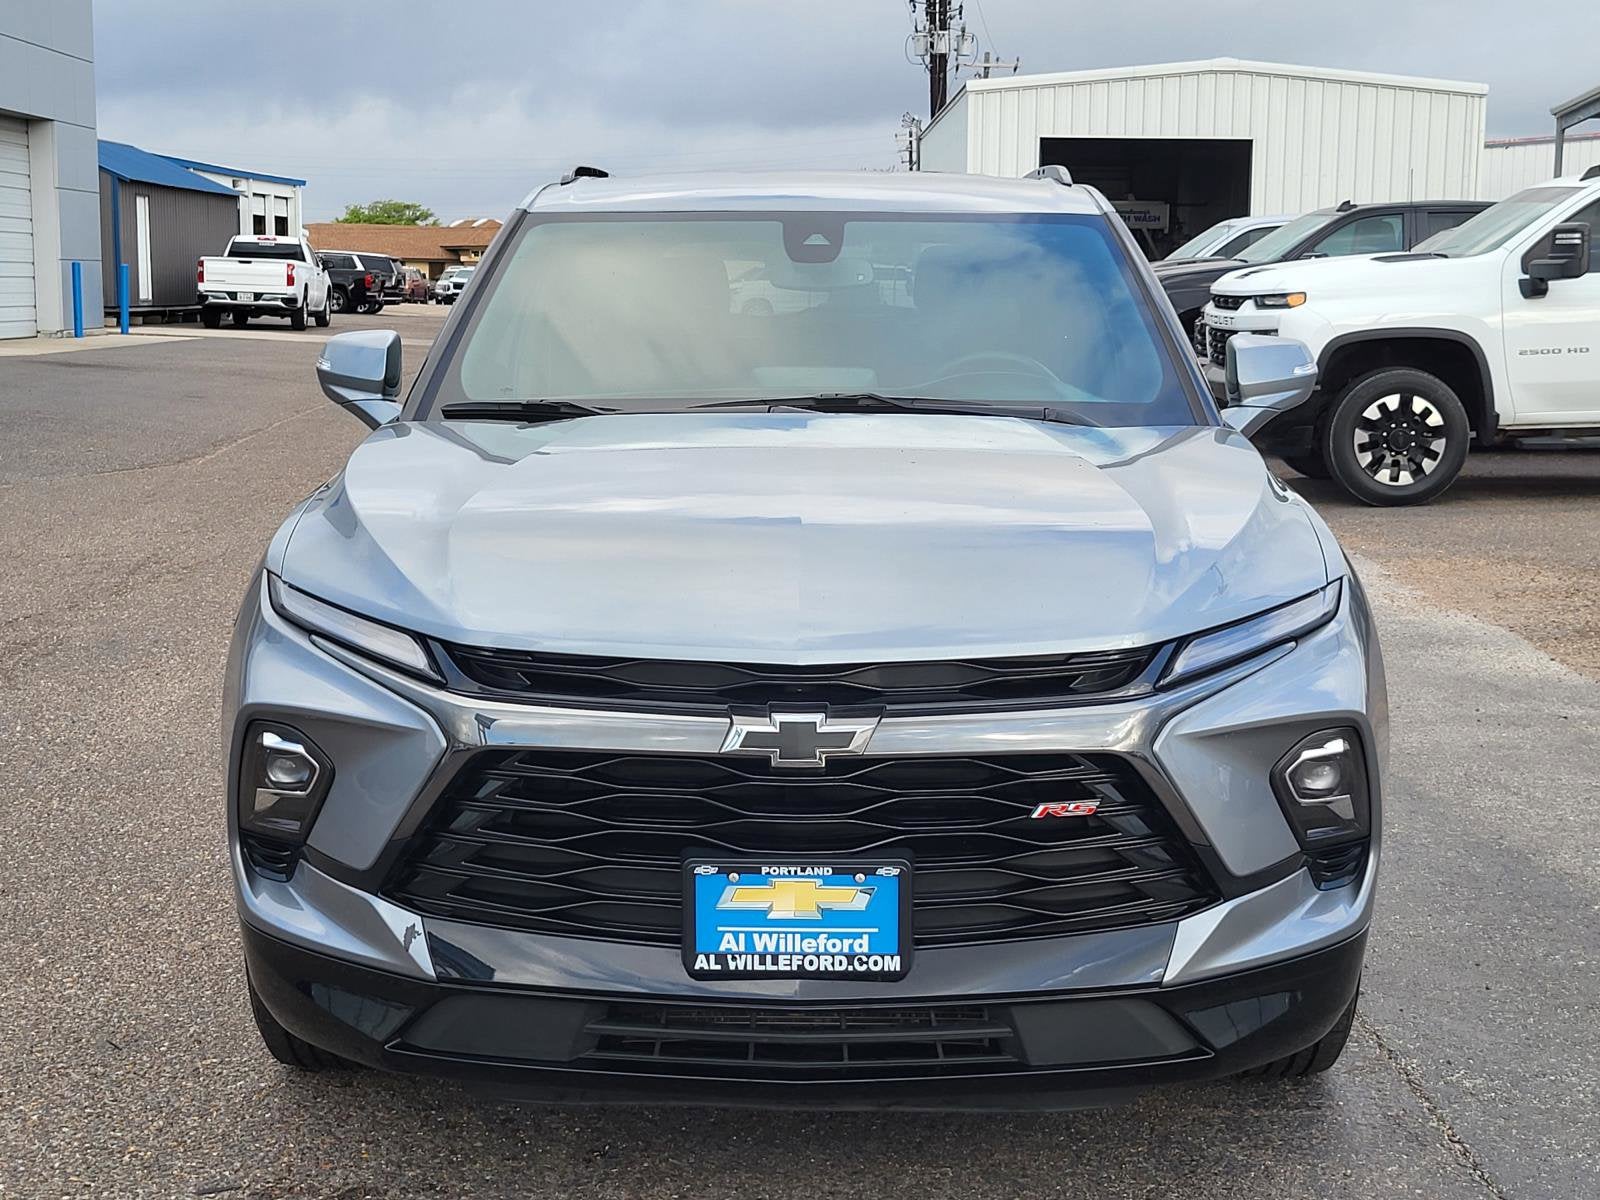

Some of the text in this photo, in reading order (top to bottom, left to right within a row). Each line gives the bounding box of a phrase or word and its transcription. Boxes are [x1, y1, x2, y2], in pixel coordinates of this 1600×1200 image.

[1134, 215, 1161, 223] WASH
[1031, 801, 1100, 819] RS
[761, 866, 833, 876] PORTLAND
[718, 932, 869, 953] Al Willeford
[694, 954, 901, 972] AL WILLEFORD.COM
